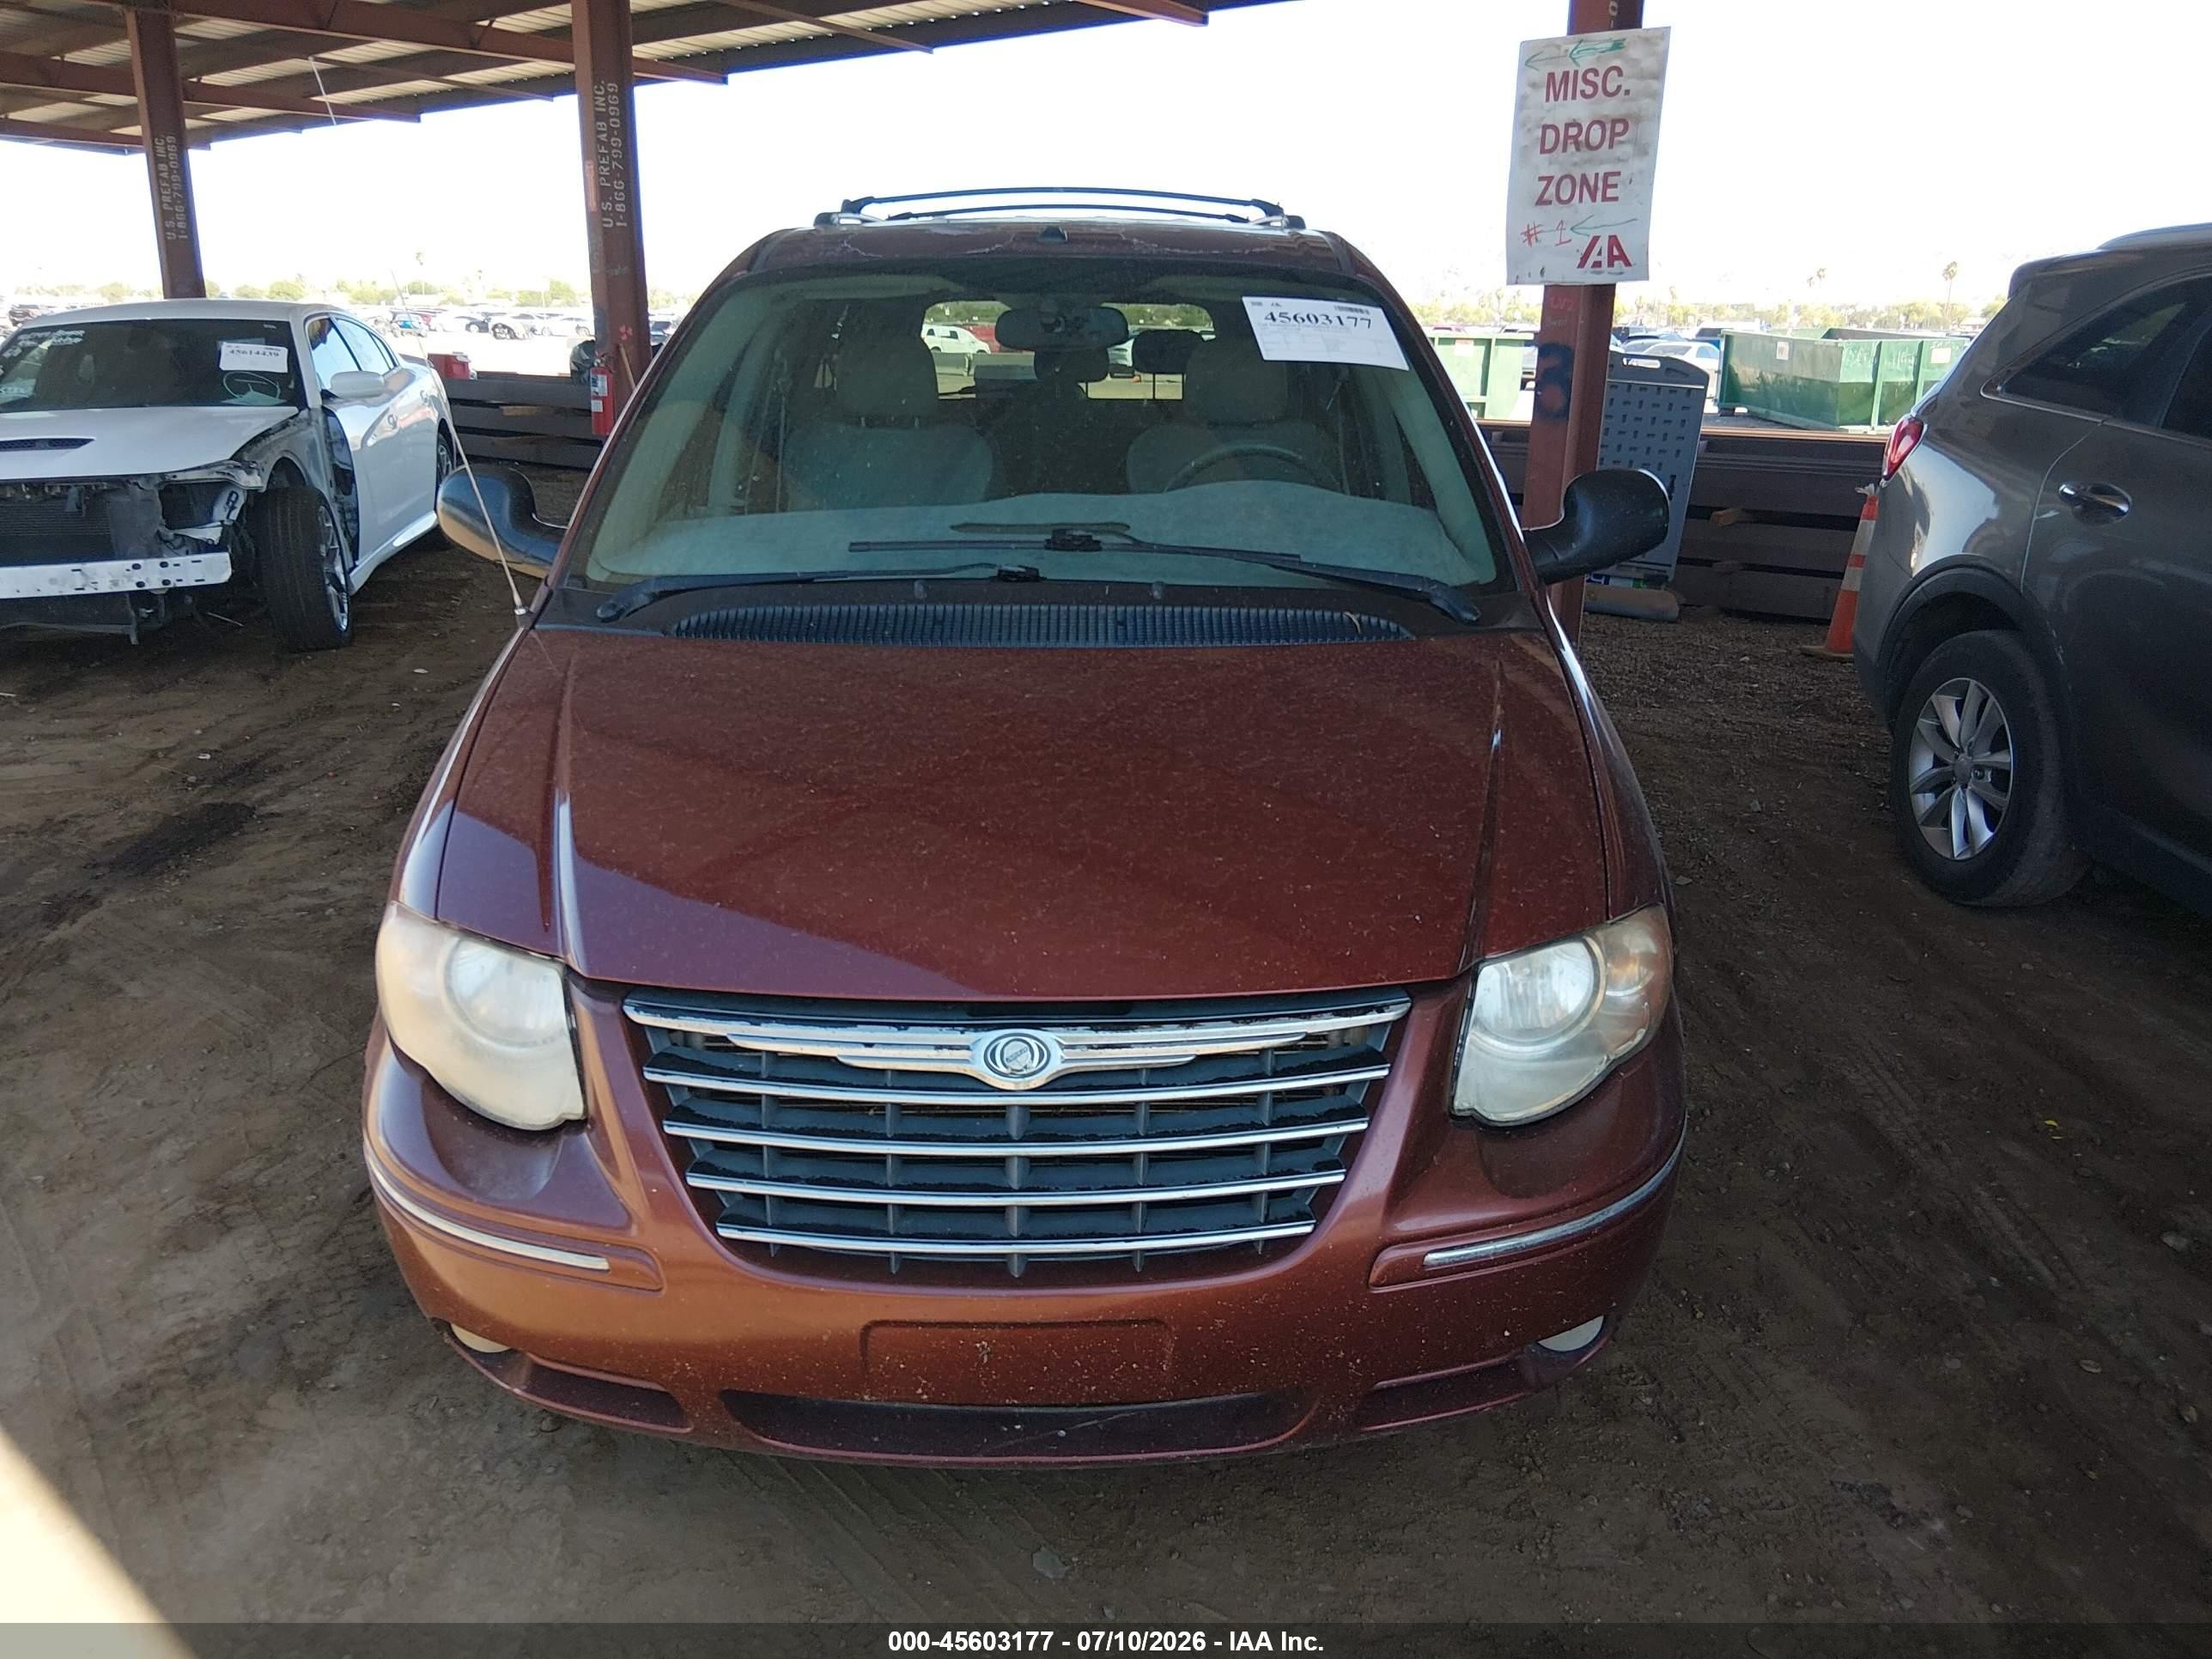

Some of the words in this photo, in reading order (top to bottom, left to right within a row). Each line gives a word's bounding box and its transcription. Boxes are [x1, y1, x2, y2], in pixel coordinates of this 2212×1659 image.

[593, 80, 606, 112] INC.
[1545, 64, 1631, 103] MISC.
[597, 121, 611, 187] PREFAB
[1539, 118, 1630, 155] DROP
[158, 163, 174, 211] PREFAB
[1534, 171, 1622, 207] ZONE
[602, 197, 614, 228] U.S.
[1264, 311, 1372, 329] 45603177
